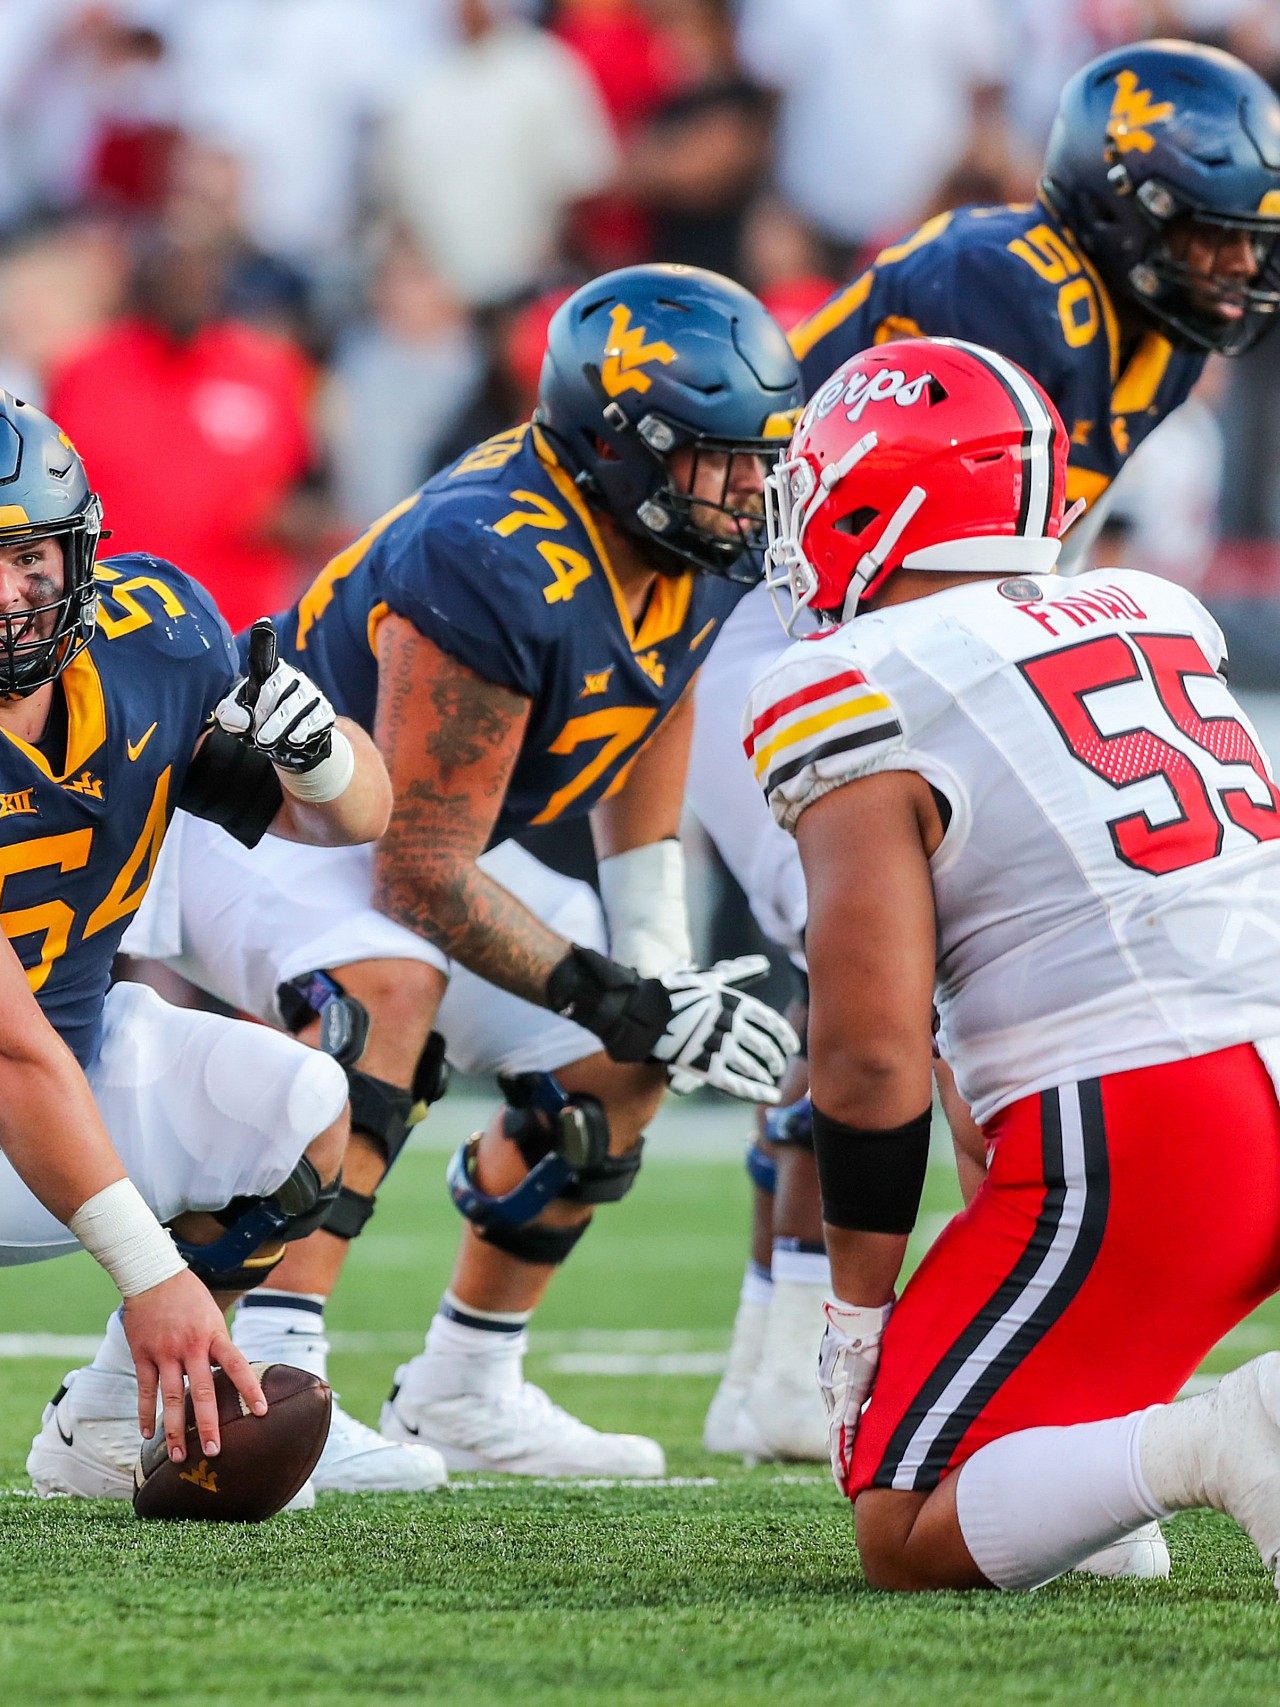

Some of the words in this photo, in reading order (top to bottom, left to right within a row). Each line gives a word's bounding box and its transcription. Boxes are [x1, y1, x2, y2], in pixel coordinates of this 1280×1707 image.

[1007, 224, 1099, 349] 50
[492, 489, 593, 605] 74
[1013, 584, 1148, 636] FINAU
[1014, 631, 1280, 877] 55
